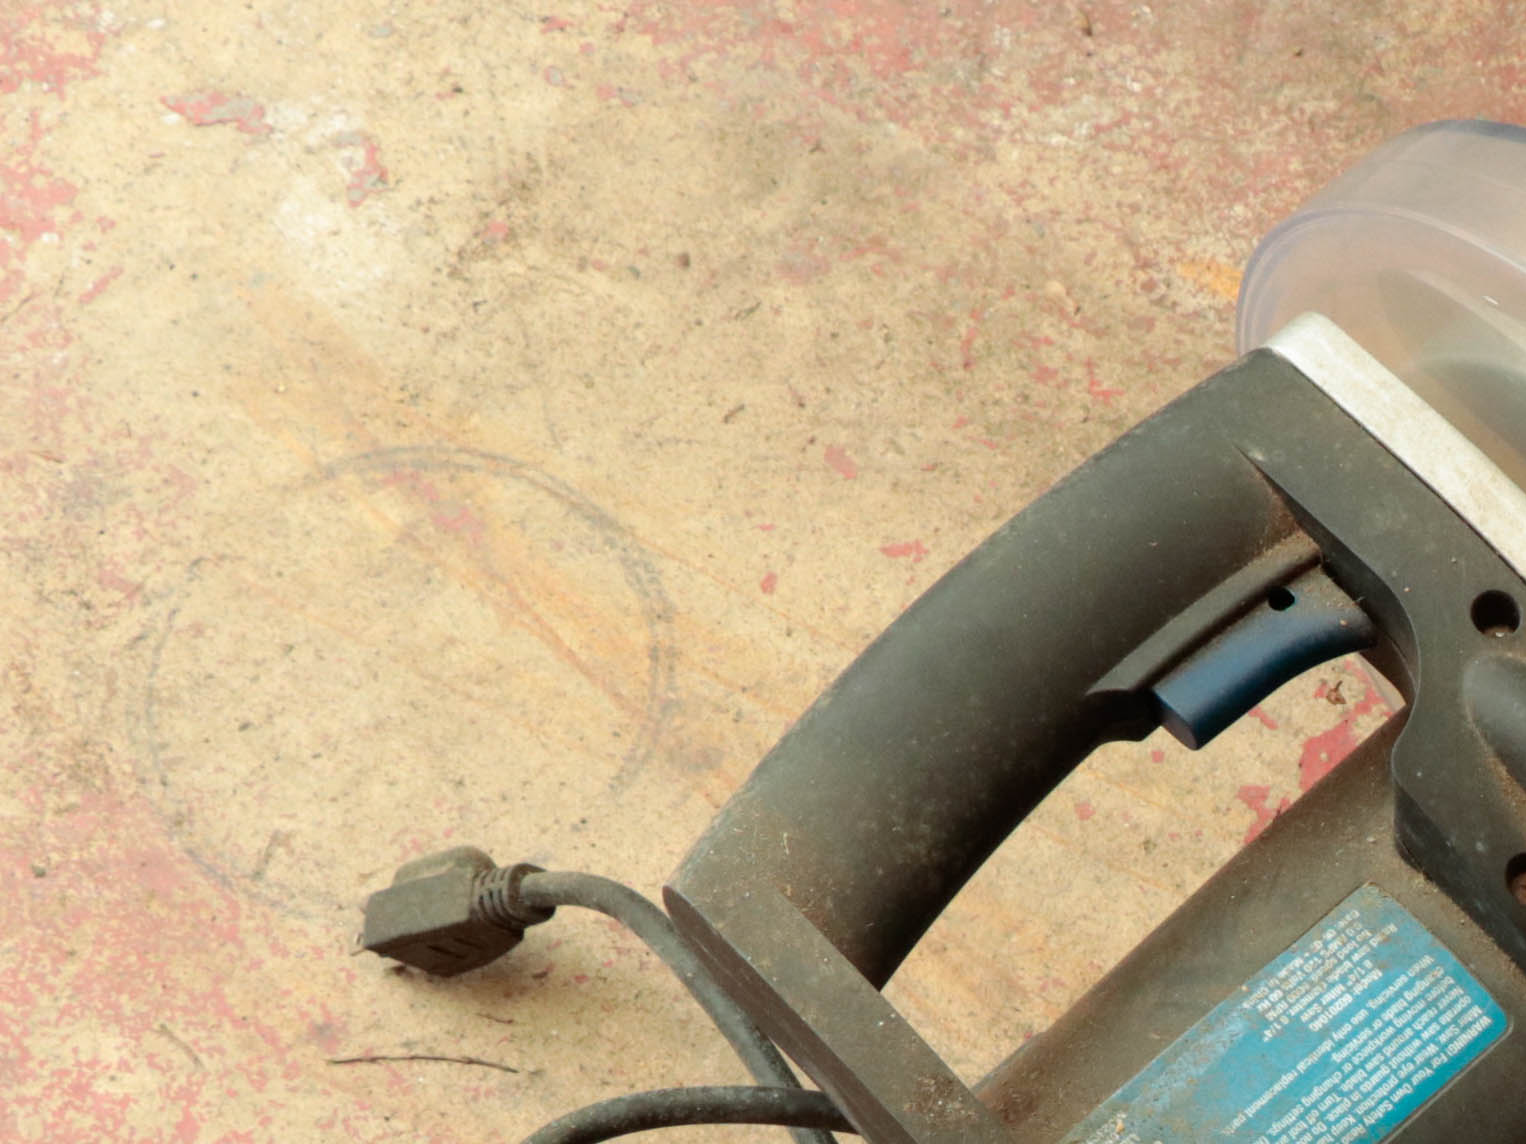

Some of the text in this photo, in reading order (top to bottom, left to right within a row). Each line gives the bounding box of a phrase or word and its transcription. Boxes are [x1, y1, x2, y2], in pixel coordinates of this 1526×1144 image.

[1350, 943, 1372, 963] saw
[1406, 953, 1434, 978] When
[1267, 987, 1284, 1003] 60
[1318, 982, 1346, 1007] Miter
[1422, 974, 1454, 1003] before
[1434, 984, 1464, 1011] Never
[1254, 998, 1272, 1013] Hz
[1263, 998, 1289, 1021] RPM
[1298, 1001, 1323, 1024] Saw
[1349, 1008, 1369, 1026] use
[1380, 997, 1408, 1022] blade
[1391, 997, 1426, 1028] moving
[1436, 993, 1472, 1025] operate
[1456, 1004, 1482, 1028] Miter
[1369, 1017, 1383, 1030] or
[1410, 1005, 1440, 1032] reach
[1419, 1020, 1441, 1040] saw
[1329, 1021, 1354, 1043] only
[1380, 1026, 1415, 1057] around
[1444, 1014, 1493, 1057] WARNING!
[1294, 1037, 1336, 1073] identical
[1348, 1023, 1396, 1065] workpiece
[1386, 1036, 1423, 1069] without
[1412, 1041, 1439, 1066] Wear
[1339, 1060, 1353, 1073] or
[1362, 1051, 1385, 1072] saw
[1394, 1060, 1415, 1079] eye
[1429, 1051, 1449, 1069] For
[1357, 1063, 1391, 1093] guards
[1409, 1064, 1434, 1087] Your
[1242, 1068, 1299, 1117] replacement
[1299, 1068, 1344, 1108] changing
[1347, 1089, 1361, 1102] in
[1388, 1082, 1413, 1104] Own
[1315, 1090, 1341, 1113] Turn
[1361, 1098, 1394, 1127] Safety
[1303, 1107, 1321, 1124] off
[1328, 1111, 1356, 1137] Keep
[1286, 1119, 1308, 1139] tool
[1309, 1119, 1327, 1136] Do
